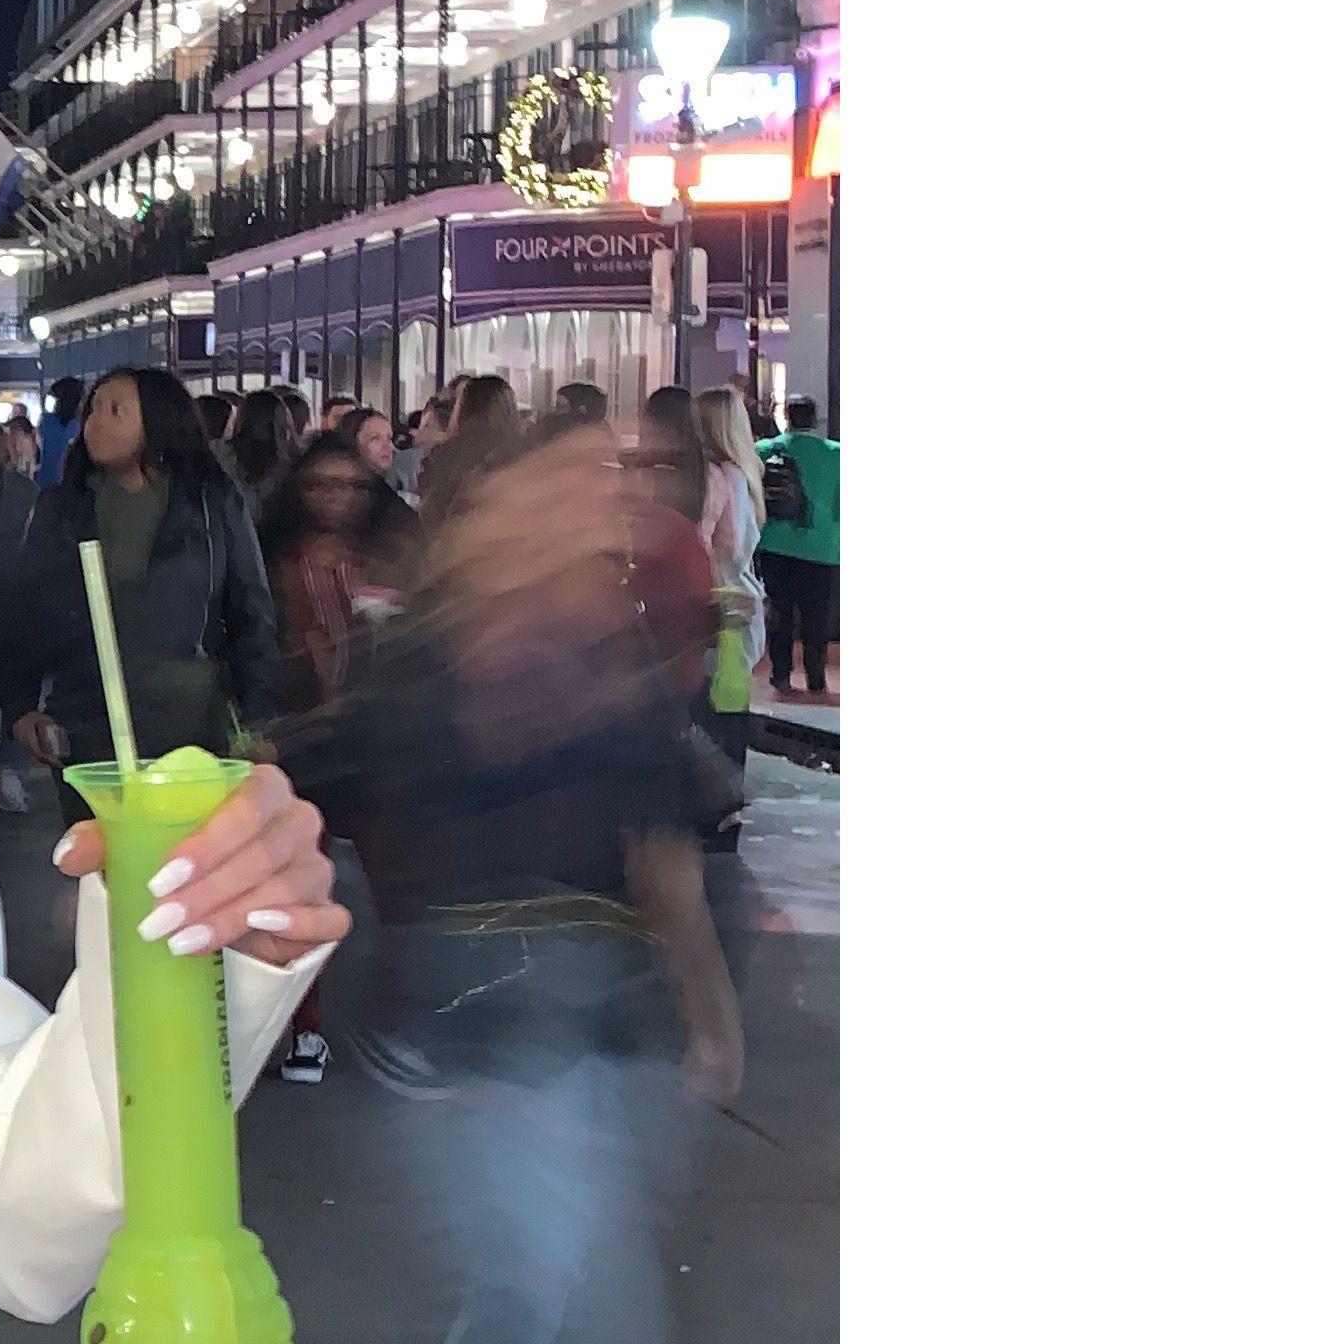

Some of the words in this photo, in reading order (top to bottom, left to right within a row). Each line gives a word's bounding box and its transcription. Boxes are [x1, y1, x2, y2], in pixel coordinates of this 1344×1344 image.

[634, 131, 682, 144] FROZ
[495, 237, 549, 262] FOUR
[573, 231, 666, 258] POINTS
